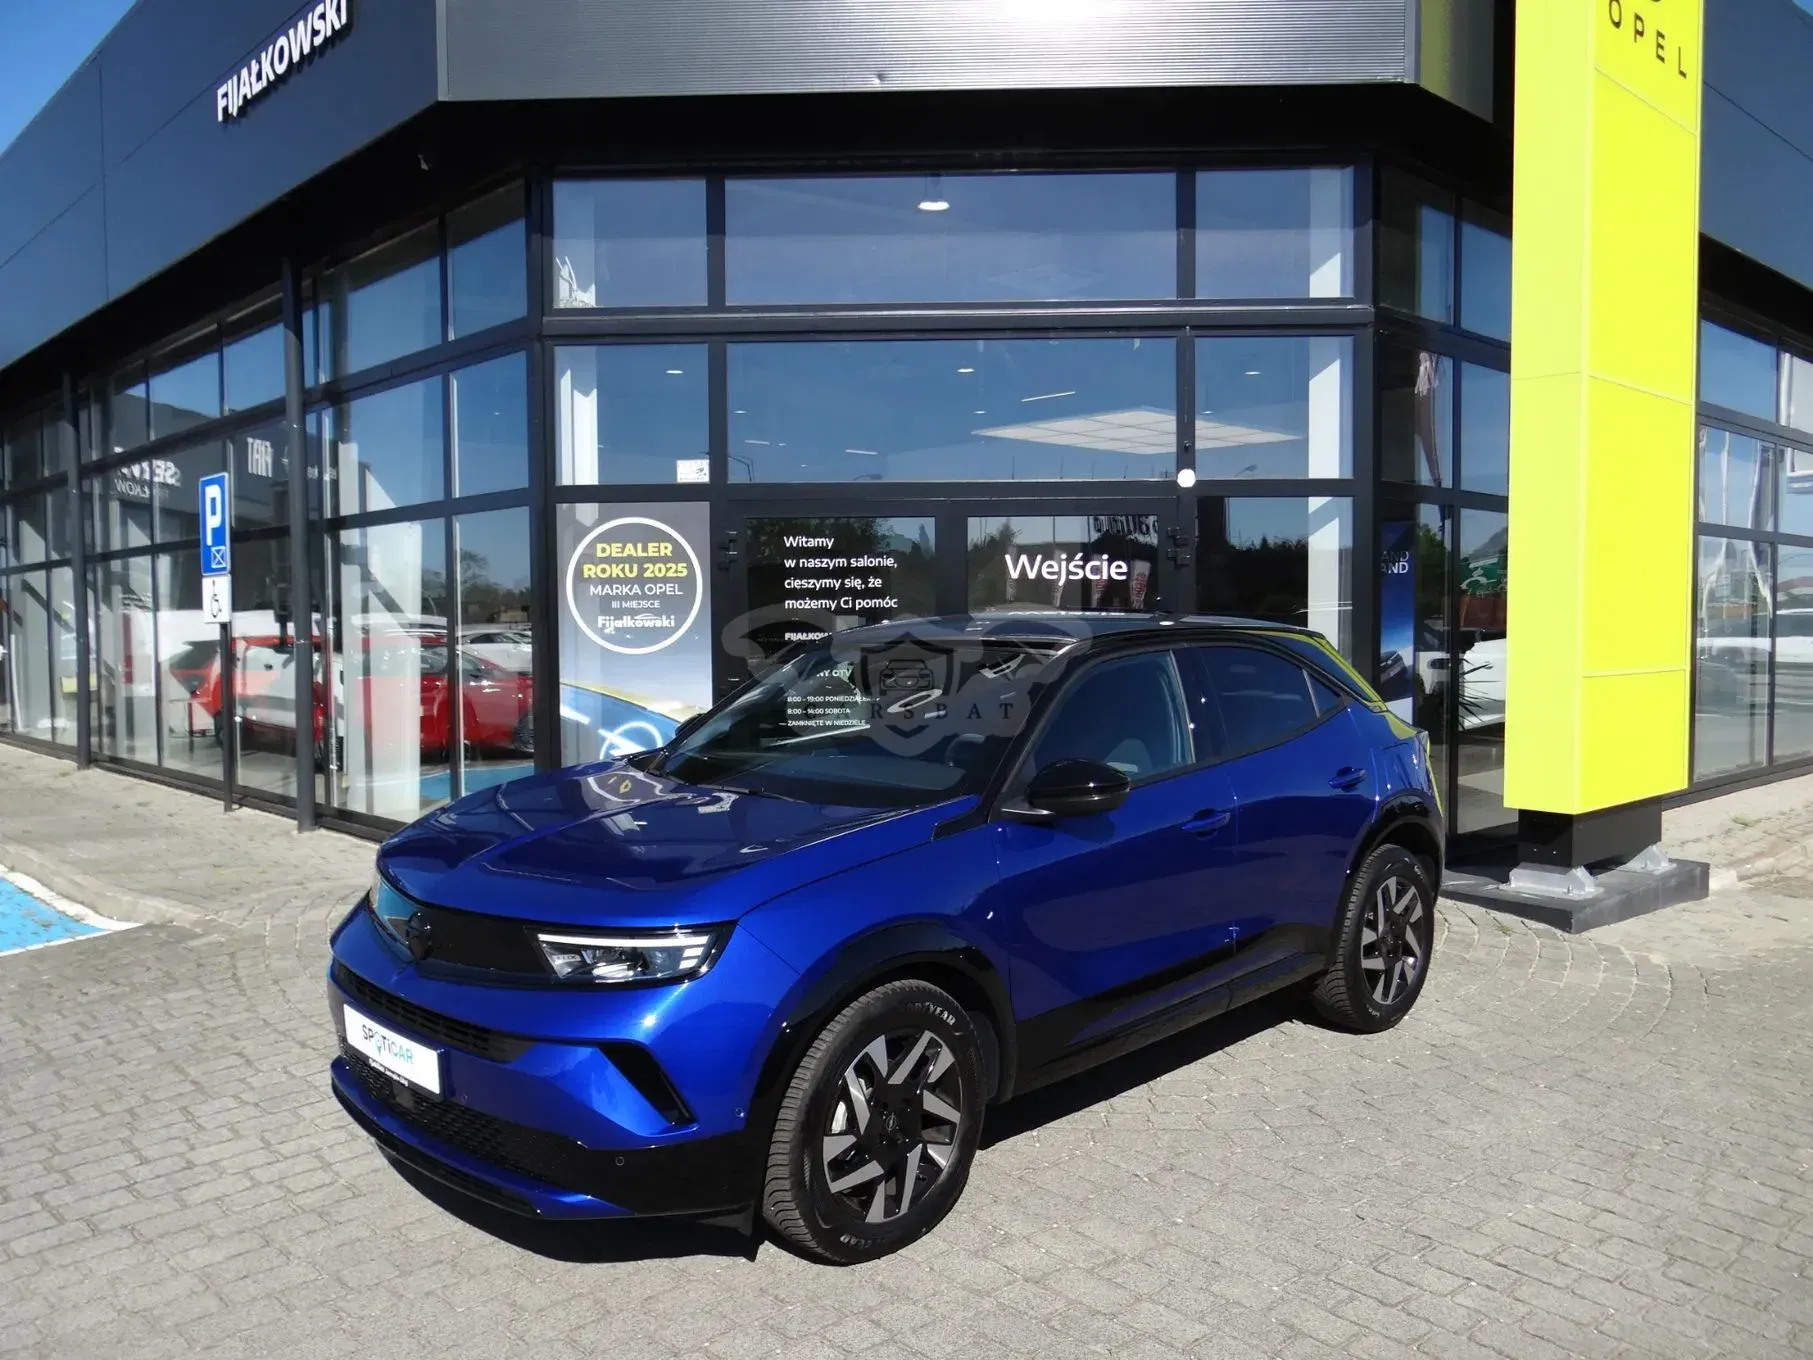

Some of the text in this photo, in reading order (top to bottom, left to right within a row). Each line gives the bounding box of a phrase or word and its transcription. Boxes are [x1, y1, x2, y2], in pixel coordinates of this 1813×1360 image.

[1608, 0, 1688, 80] OPEL
[217, 0, 347, 122] FIJAŁKOWSKI
[205, 484, 223, 546] P
[596, 542, 673, 557] DEALER
[783, 536, 834, 549] Witamy
[784, 555, 897, 570] w naszym salonie,
[1004, 552, 1129, 587] Wejście
[583, 563, 688, 578] ROKU 2025
[590, 583, 683, 596] MARKA OPEL
[784, 576, 882, 590] cieszymy się, że
[622, 600, 660, 608] MIEJSCE
[784, 596, 898, 611] możemy Ci pomóc
